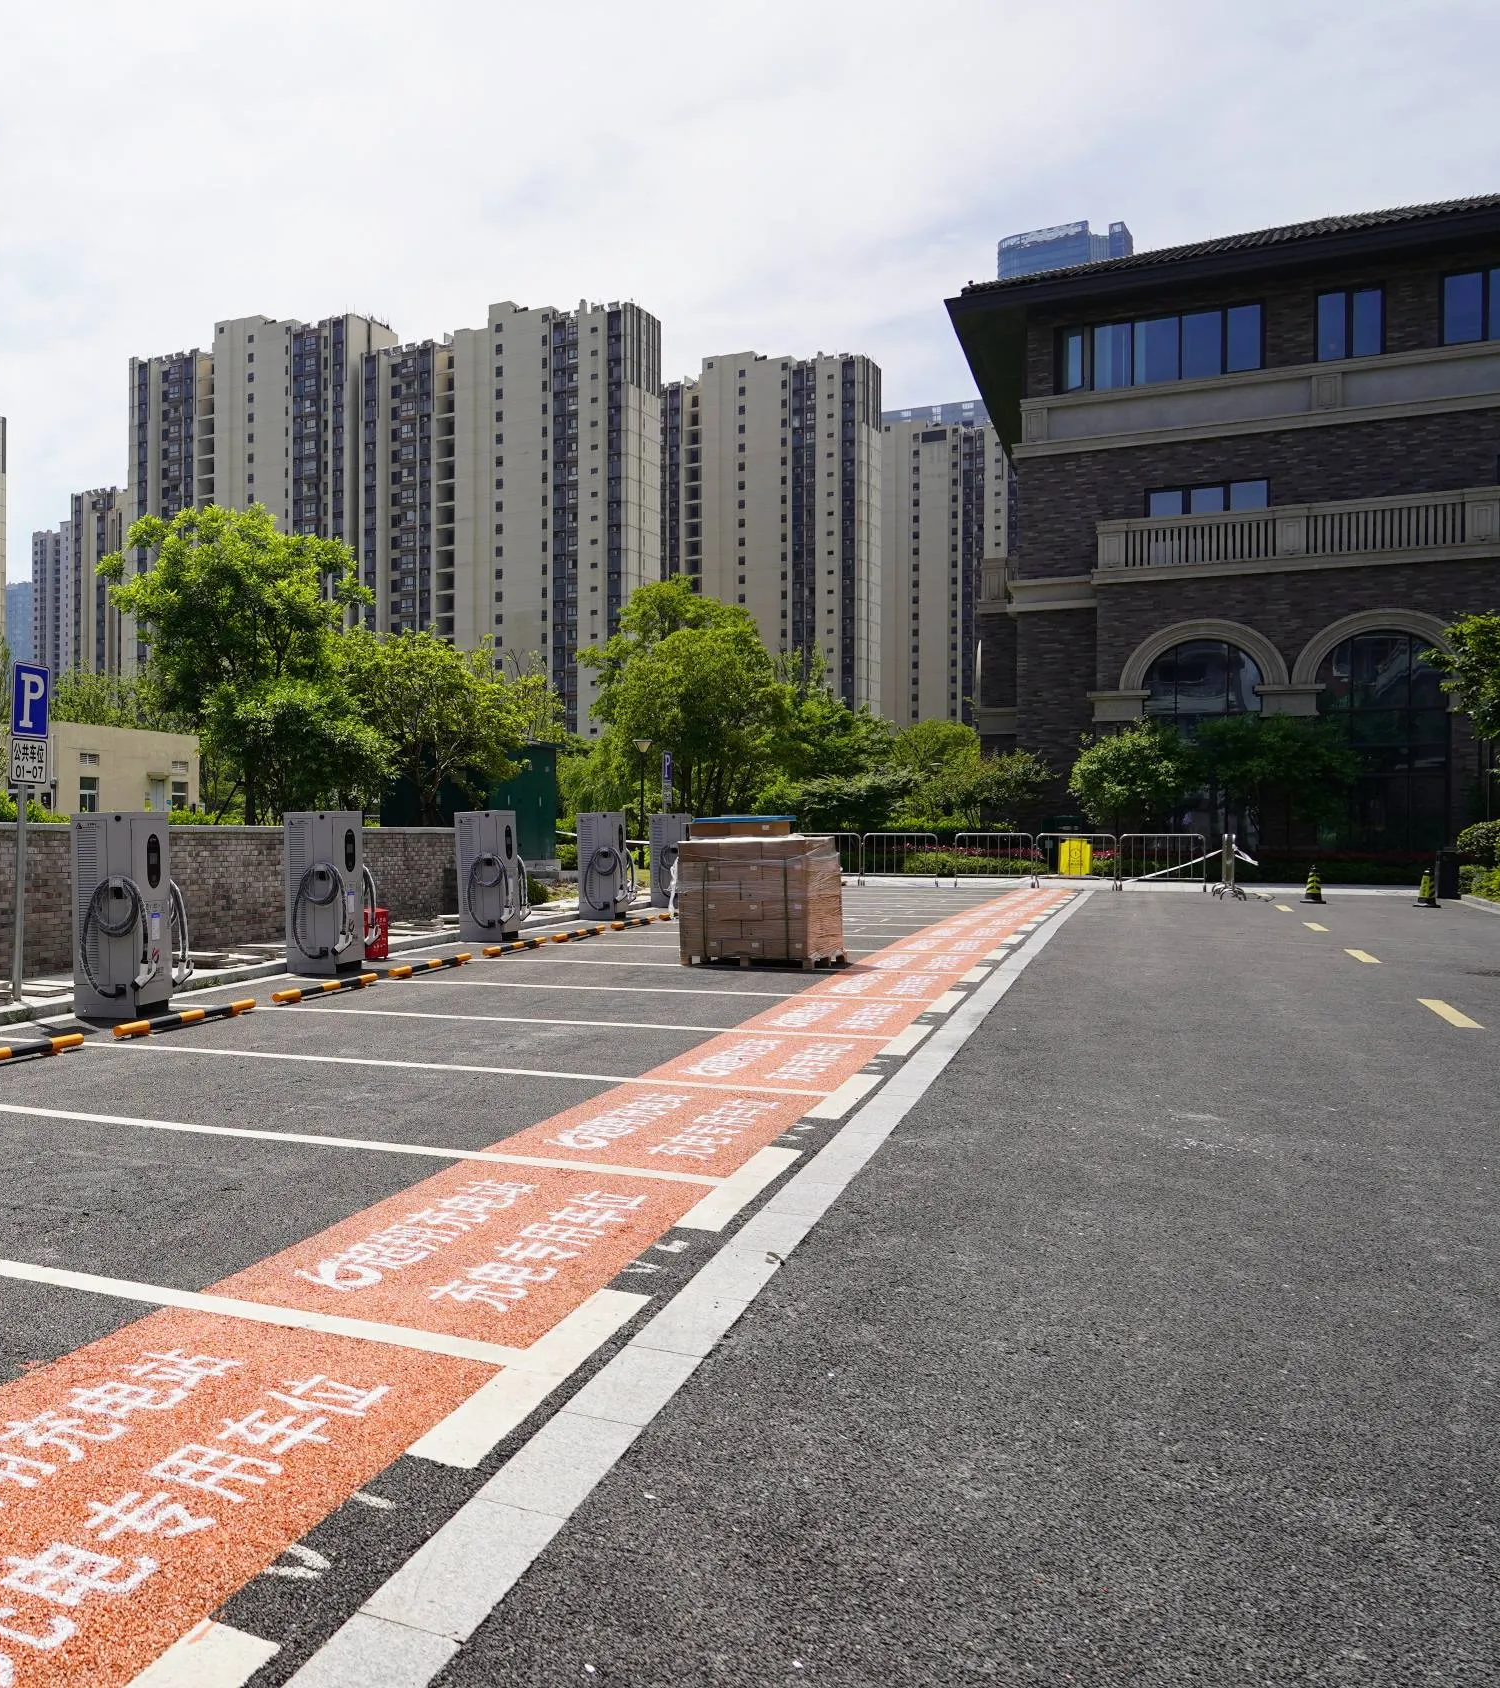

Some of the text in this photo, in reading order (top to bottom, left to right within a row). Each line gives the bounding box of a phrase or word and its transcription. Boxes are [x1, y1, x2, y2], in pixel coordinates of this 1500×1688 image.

[19, 672, 45, 728] P
[13, 742, 44, 764] 公共车位
[15, 764, 43, 779] 01-07
[664, 754, 671, 778] P
[646, 1098, 781, 1160] 充电专用车位
[333, 1179, 540, 1270] 超翔充电站
[427, 1190, 650, 1313] 充电专用车位
